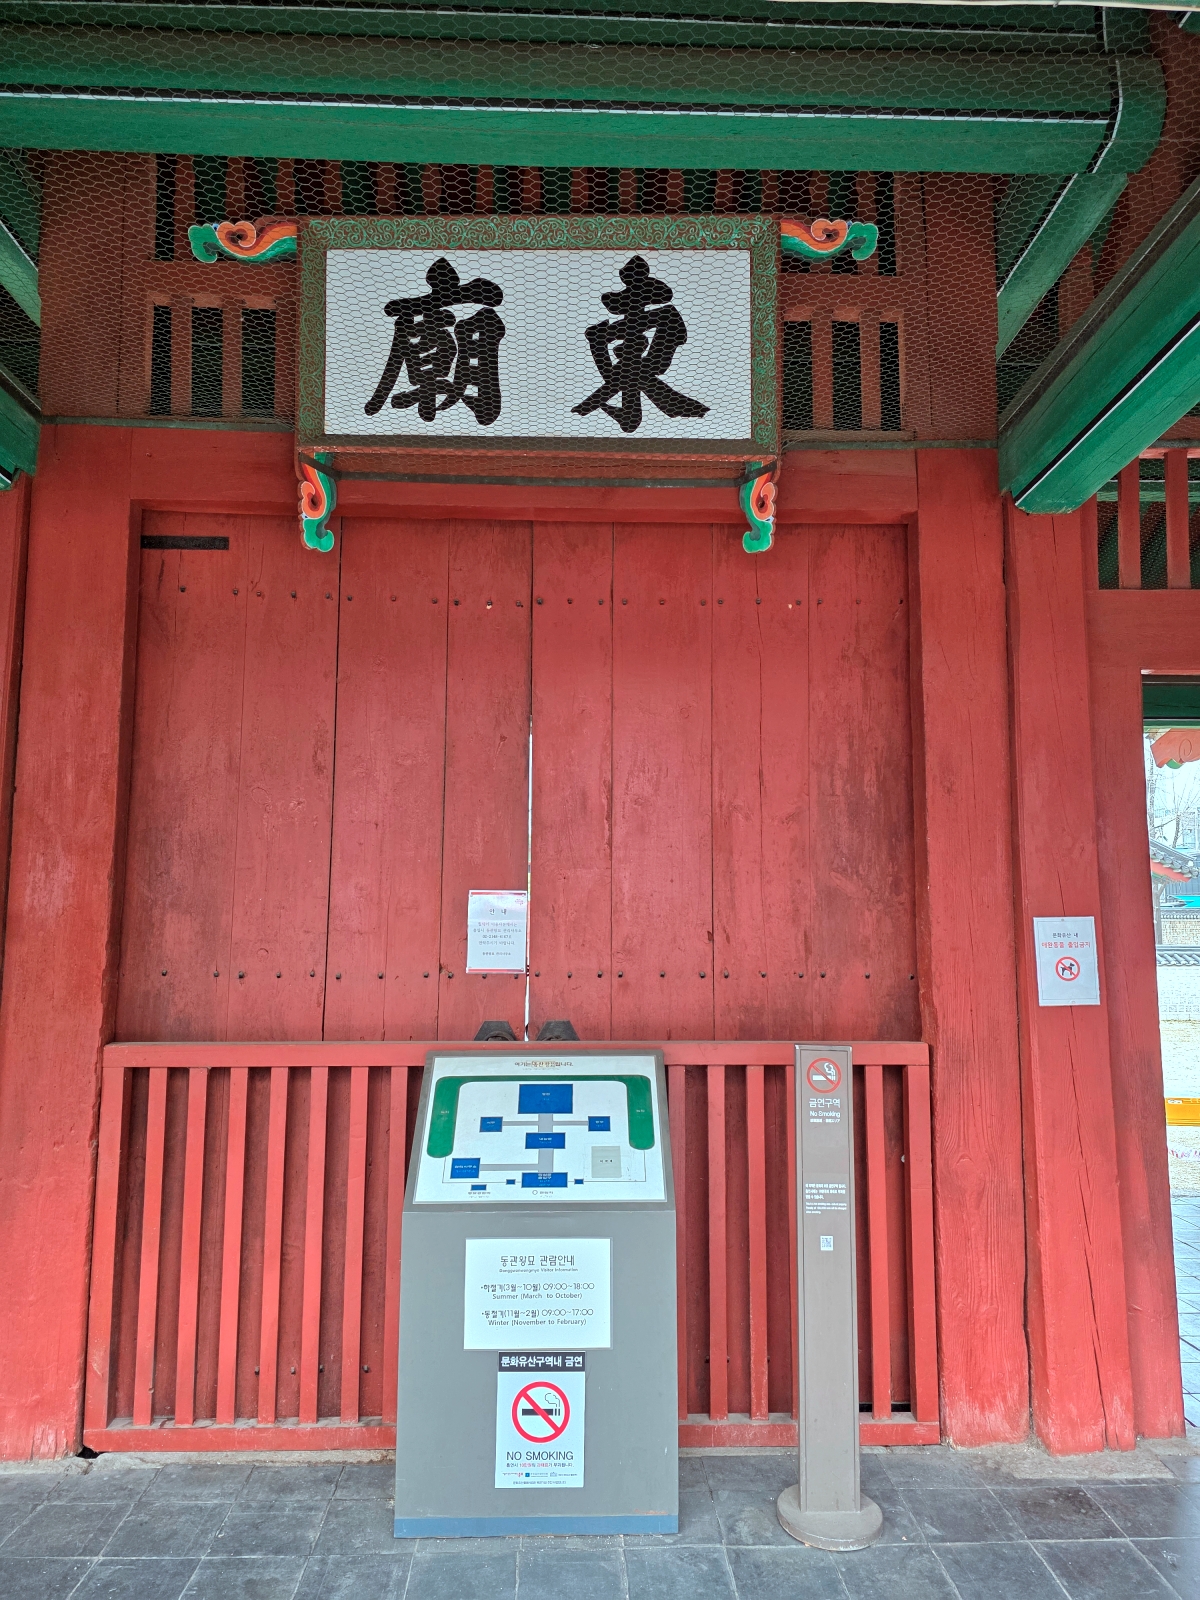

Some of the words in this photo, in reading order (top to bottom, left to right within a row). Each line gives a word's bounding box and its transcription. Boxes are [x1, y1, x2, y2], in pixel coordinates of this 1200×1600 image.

[808, 1097, 841, 1109] 금연구역
[818, 1110, 841, 1119] Smoking
[500, 1255, 536, 1268] 동관왕묘
[539, 1255, 576, 1267] 관람안내
[542, 1282, 595, 1291] 09:00~18:00
[541, 1308, 594, 1317] 09:00~17:00
[556, 1318, 587, 1326] February)
[501, 1355, 562, 1368] 문화유산구역내
[564, 1355, 583, 1367] 금연
[506, 1451, 522, 1461] NO
[525, 1451, 574, 1461] SMOKING
